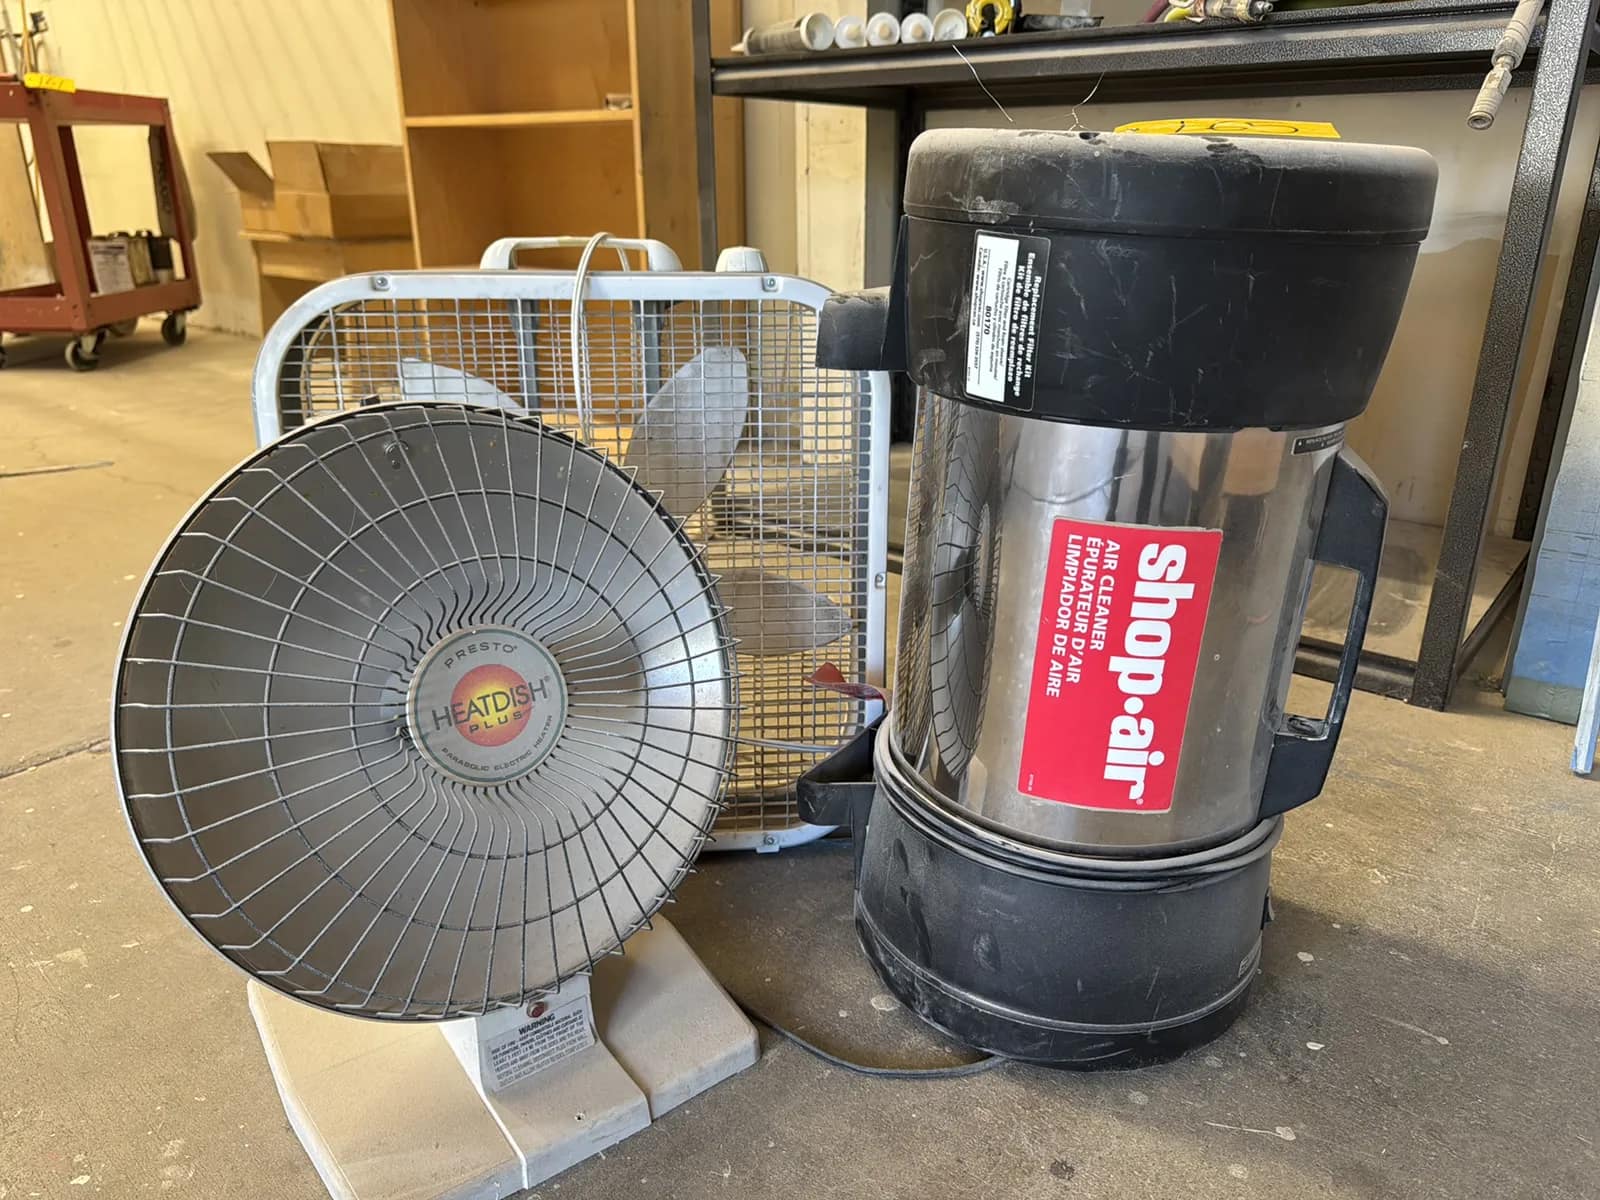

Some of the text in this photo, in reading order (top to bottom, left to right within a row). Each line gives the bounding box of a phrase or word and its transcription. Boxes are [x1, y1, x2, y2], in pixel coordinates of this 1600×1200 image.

[983, 305, 992, 335] 80170
[1007, 264, 1025, 382] Kit de filtro de reemplazo
[1013, 252, 1035, 396] Ensemble de filtres de rechange
[1023, 275, 1041, 378] Replacement Filter Kit
[1046, 533, 1083, 698] LIMPIADOR DE AIRE
[1072, 536, 1104, 635] ÉPURATEUR
[1089, 539, 1121, 651] AIR CLEANER
[432, 679, 548, 731] HEATDISH
[441, 715, 553, 771] PARABOLIC ELECTRIC HEATER
[469, 711, 523, 734] PLUS
[518, 1012, 555, 1035] WARNING
